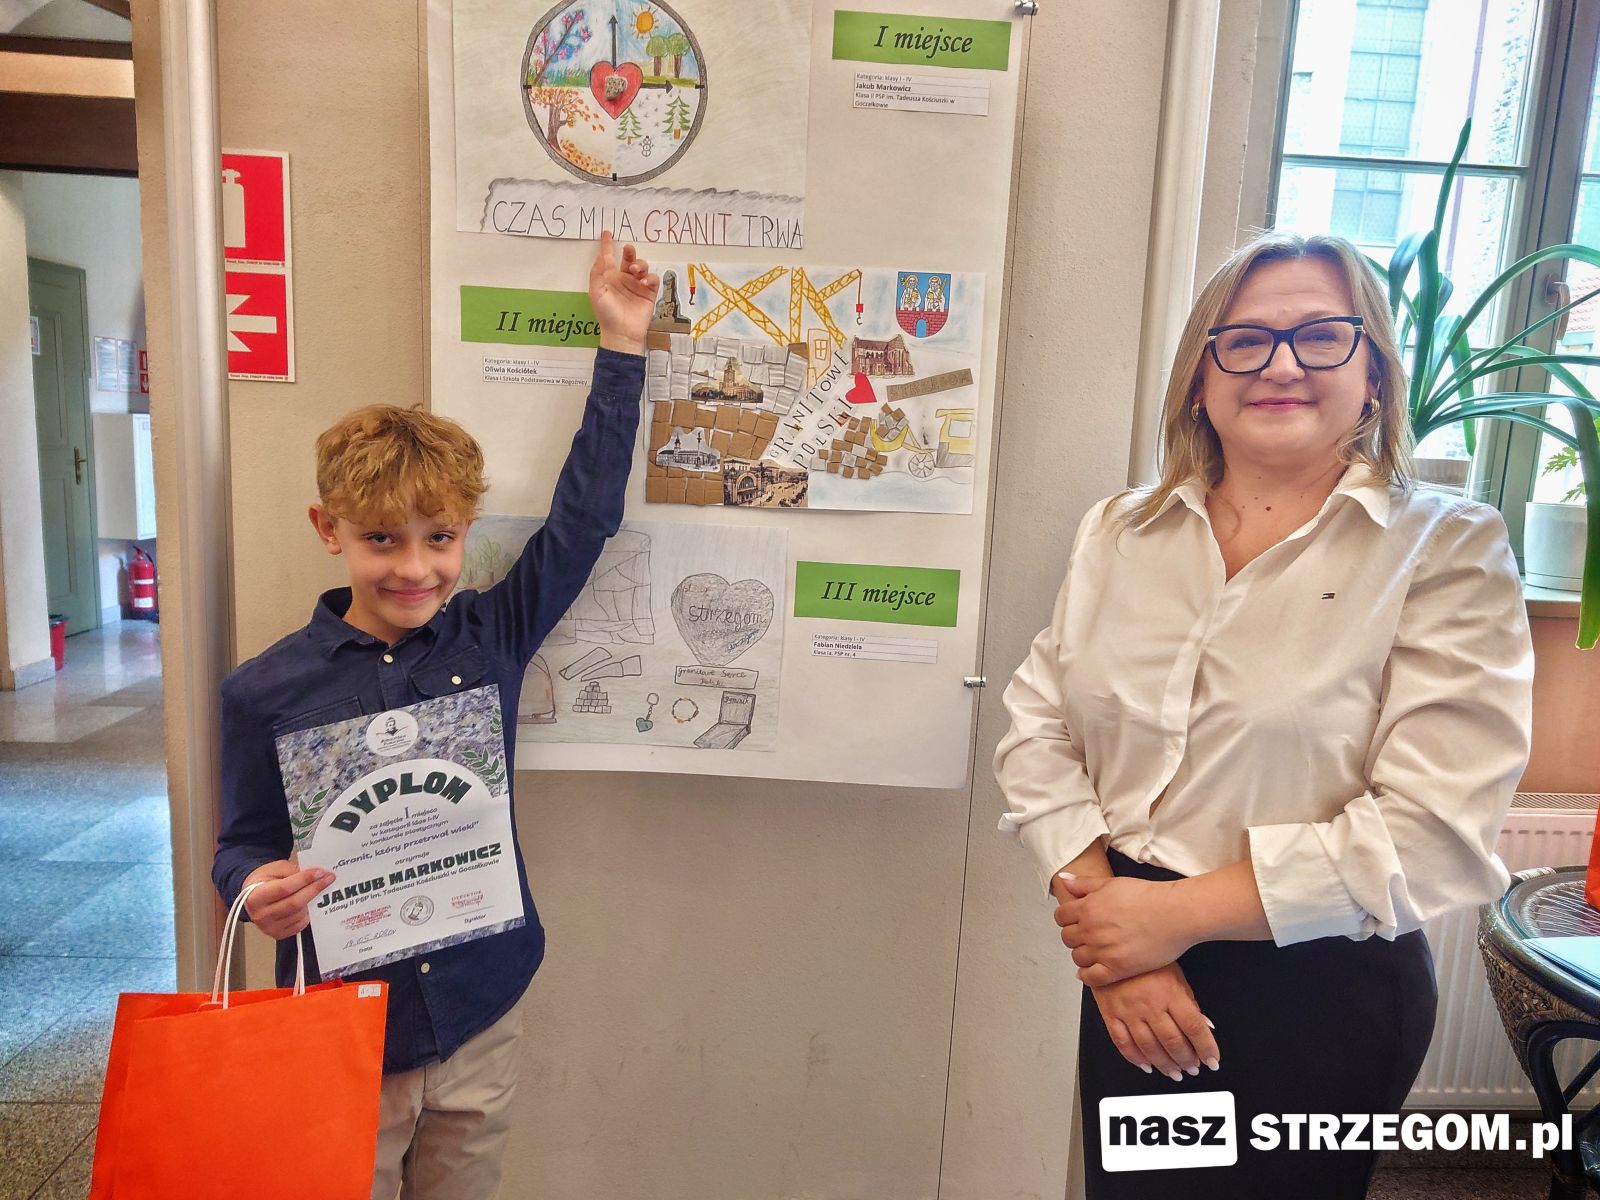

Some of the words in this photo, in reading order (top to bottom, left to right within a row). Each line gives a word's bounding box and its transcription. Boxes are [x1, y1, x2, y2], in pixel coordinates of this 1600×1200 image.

[873, 25, 889, 48] I
[894, 26, 973, 59] miejsce
[855, 82, 875, 90] Jakub
[876, 84, 912, 92] Markowicz
[922, 96, 949, 104] Kościuszki
[854, 100, 889, 108] Goczałkowie
[491, 201, 566, 237] CZAS
[643, 209, 733, 246] GRANIT
[741, 214, 804, 249] TRWA
[496, 311, 522, 332] II
[528, 312, 601, 342] miejsce
[506, 367, 537, 375] Kościółek
[521, 376, 555, 384] Podstawowa
[769, 350, 849, 458] GRANITOWE
[820, 581, 857, 602] III
[862, 582, 936, 611] miejsce
[813, 641, 834, 649] Fabian
[834, 642, 863, 650] Niedziela
[330, 771, 472, 833] DYPLOM
[404, 806, 410, 819] I
[369, 832, 404, 846] konkursie
[404, 819, 449, 837] plastycznym
[374, 844, 402, 857] który
[403, 829, 449, 849] przetrwał
[317, 876, 386, 909] JAKUB
[389, 842, 503, 886] MARKOWICZ
[329, 902, 349, 915] klasy
[382, 882, 415, 897] Tadeusza
[416, 871, 450, 888] Kościuszki
[458, 858, 500, 874] Goczałkowie
